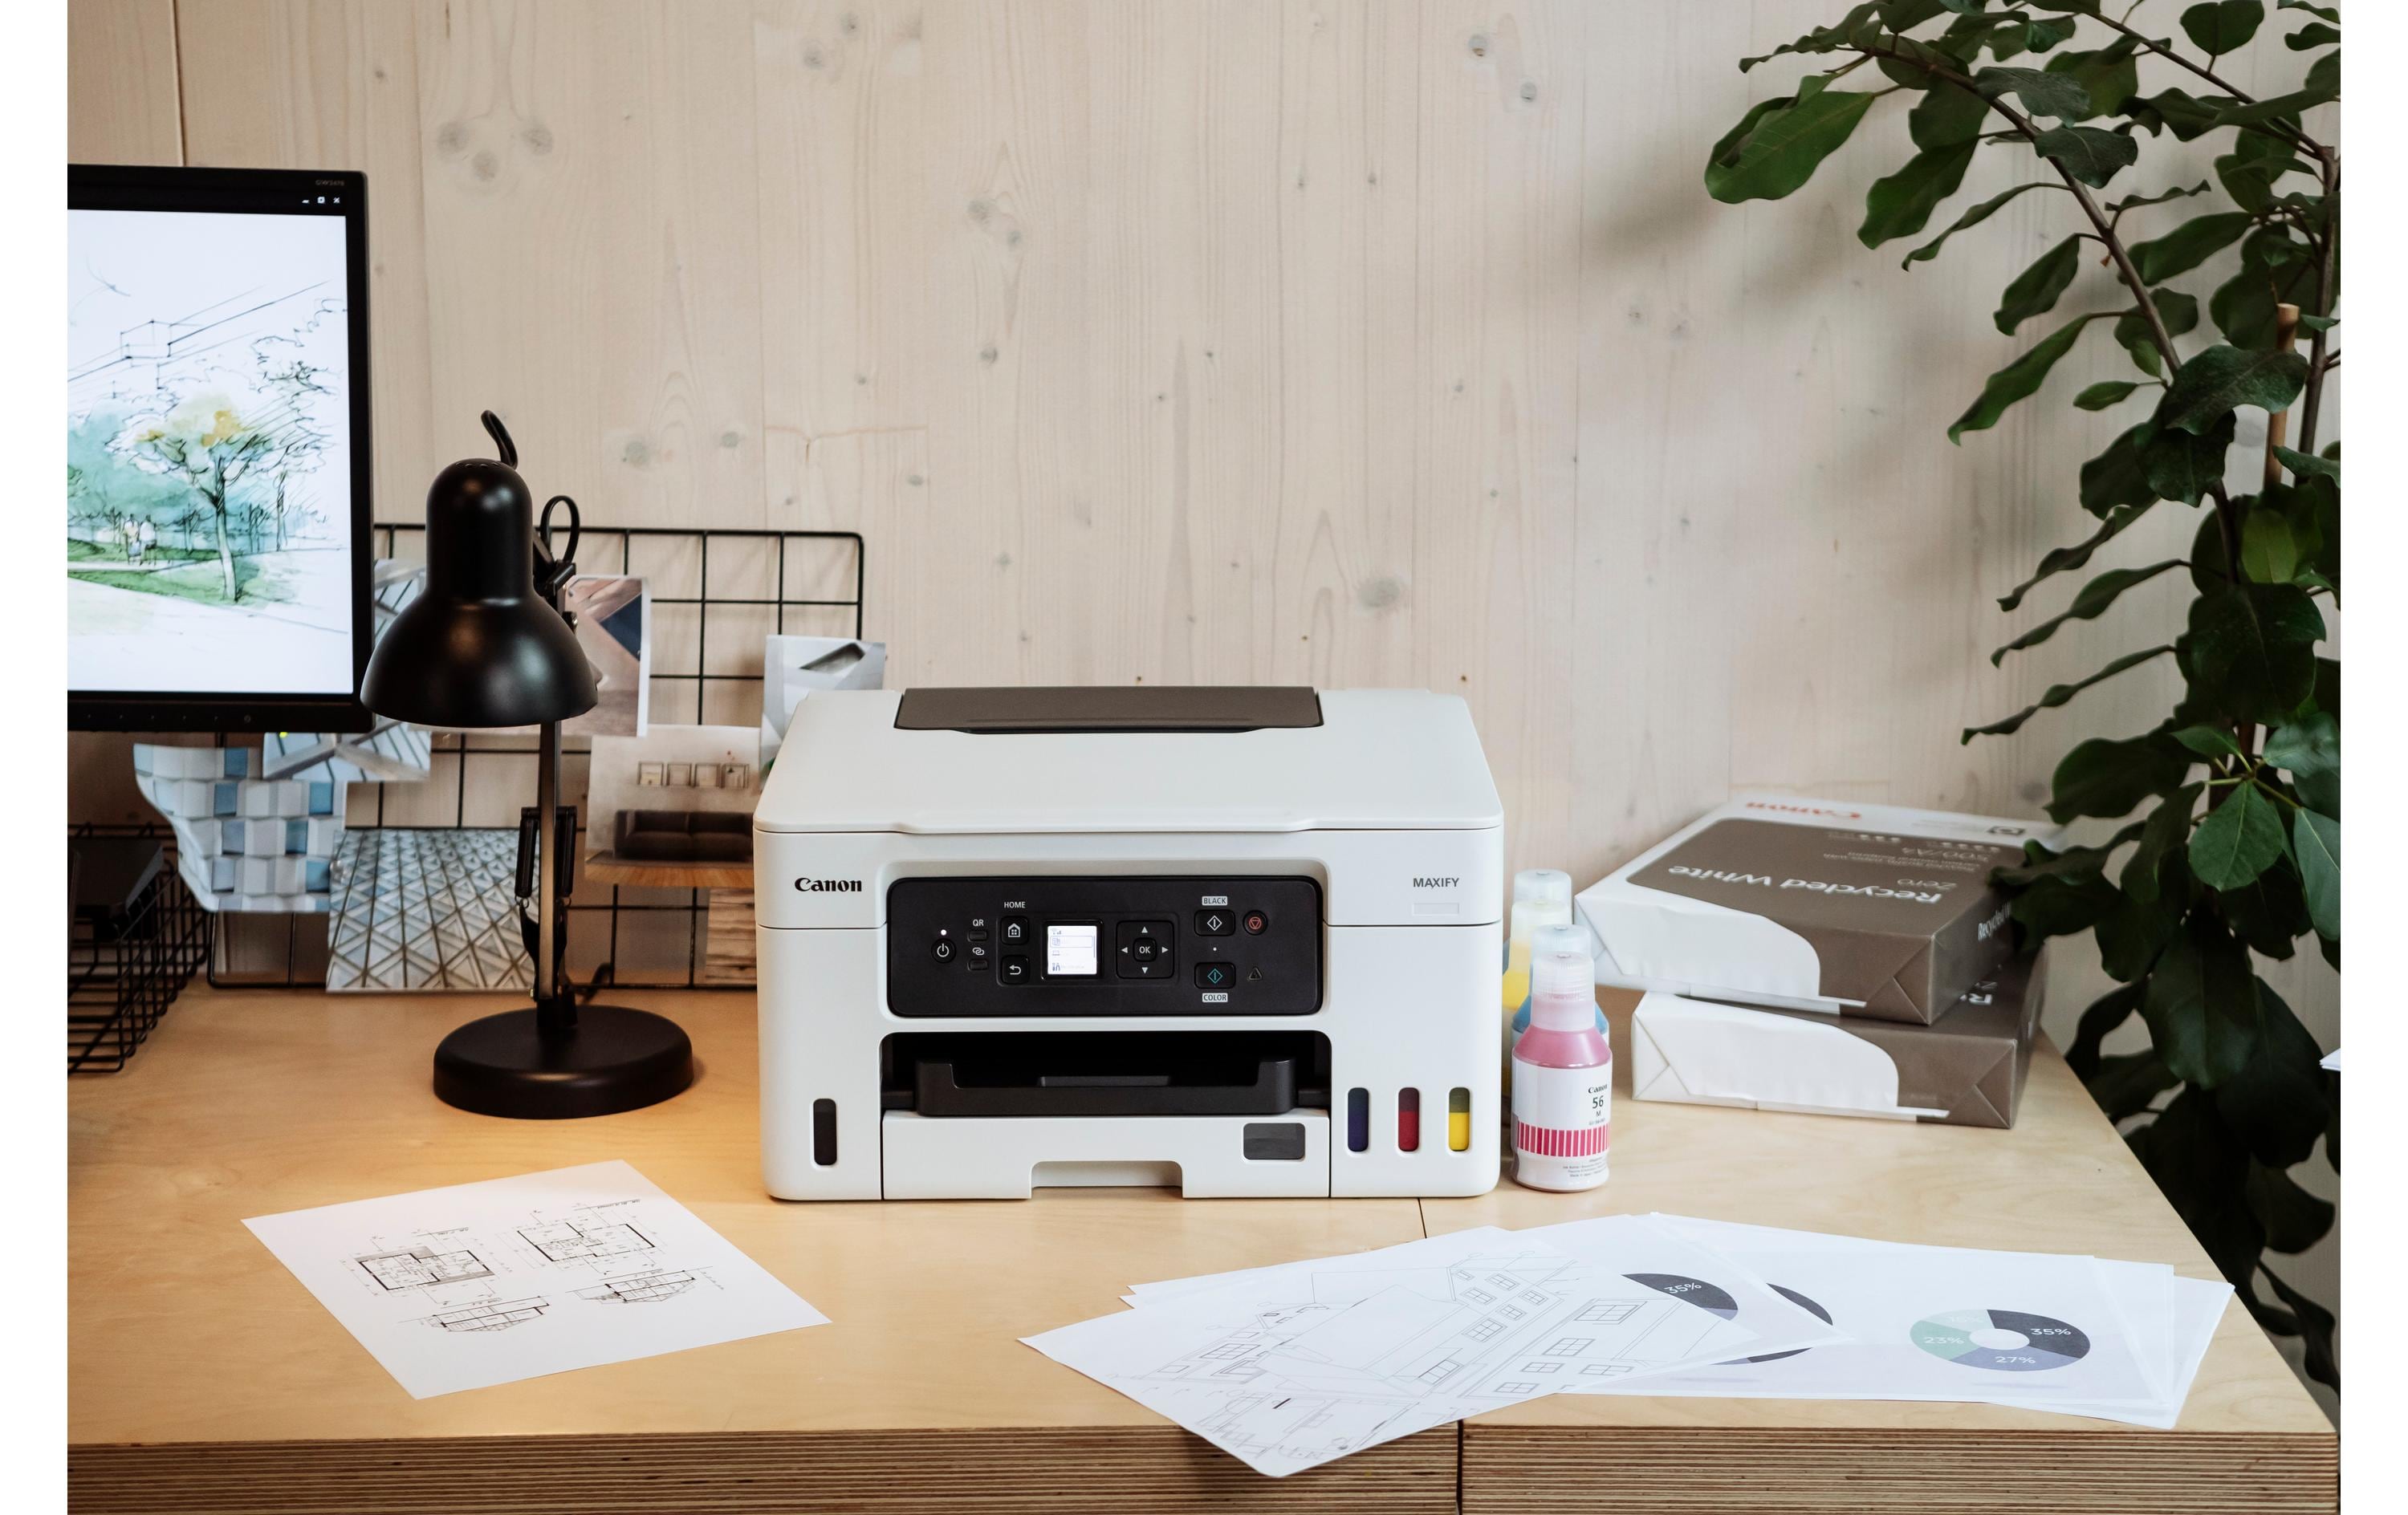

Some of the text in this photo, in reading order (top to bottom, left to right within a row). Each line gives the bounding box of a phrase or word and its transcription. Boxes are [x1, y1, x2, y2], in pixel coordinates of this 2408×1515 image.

[1746, 802, 1861, 819] Canon
[795, 877, 862, 892] Canon
[1413, 878, 1459, 887] MAXIFY
[1668, 865, 1942, 904] Recycled White
[1897, 878, 1957, 892] Zero
[972, 919, 984, 927] QR
[1139, 946, 1151, 954] OK
[1588, 1083, 1608, 1094] Canon
[1592, 1095, 1604, 1109] 56
[1664, 1282, 1702, 1294] 35%
[1924, 1336, 1966, 1344] 23%
[1995, 1356, 2036, 1364] 27%
